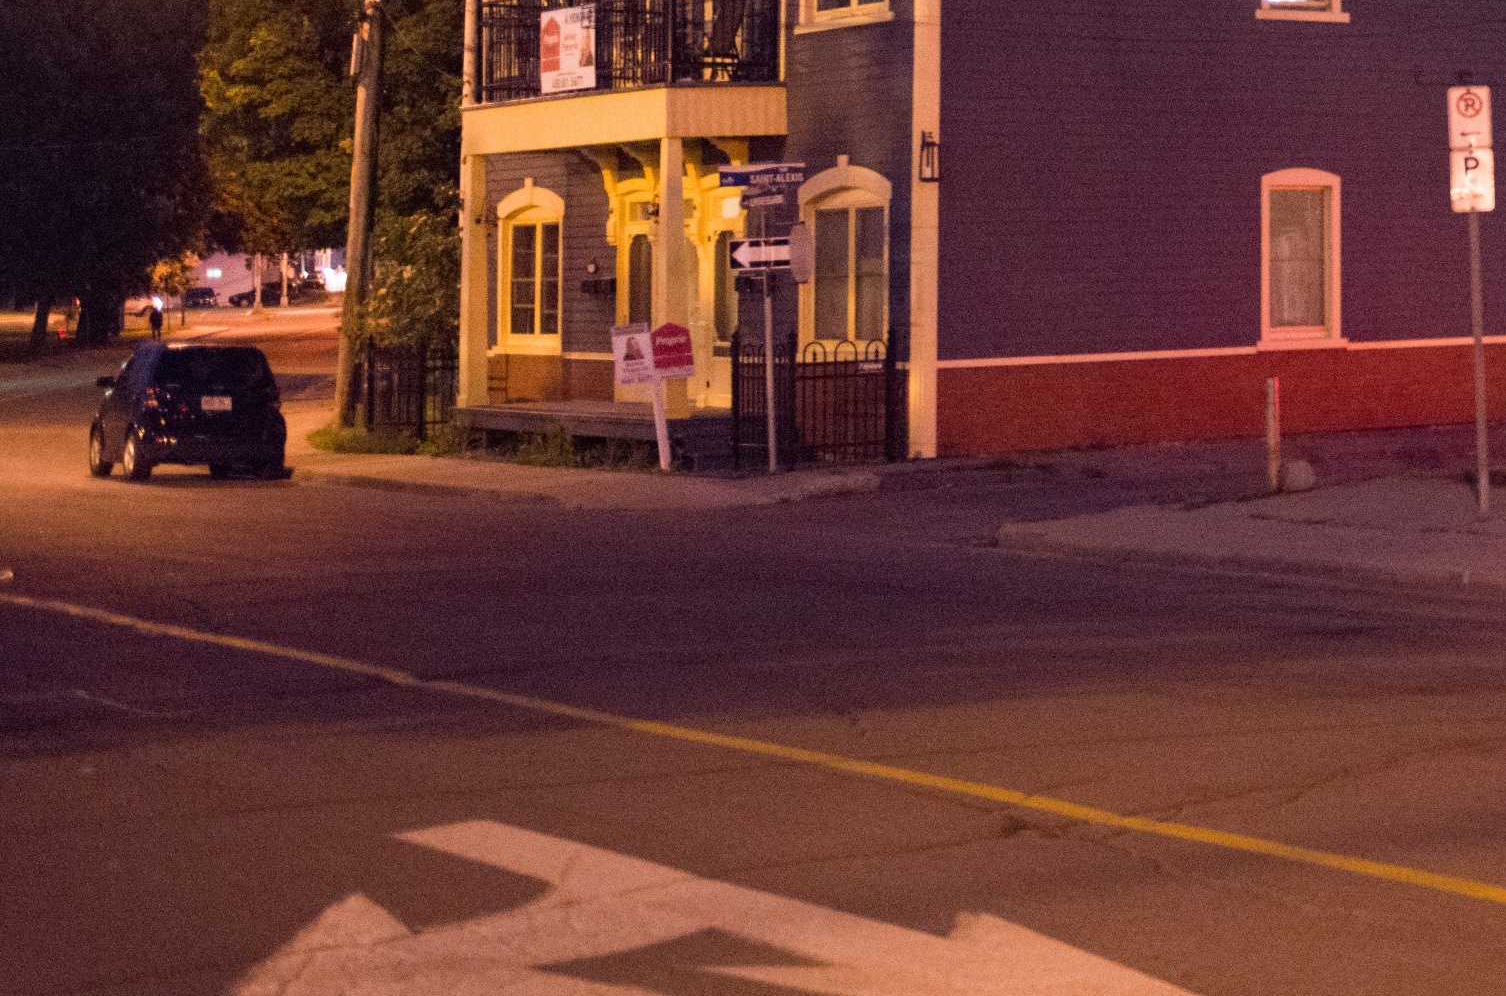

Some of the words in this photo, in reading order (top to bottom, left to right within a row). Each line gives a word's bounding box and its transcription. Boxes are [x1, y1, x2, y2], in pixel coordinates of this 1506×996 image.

[1464, 98, 1476, 112] R
[1464, 157, 1479, 175] P
[749, 172, 804, 184] SAINT-ALEXIS
